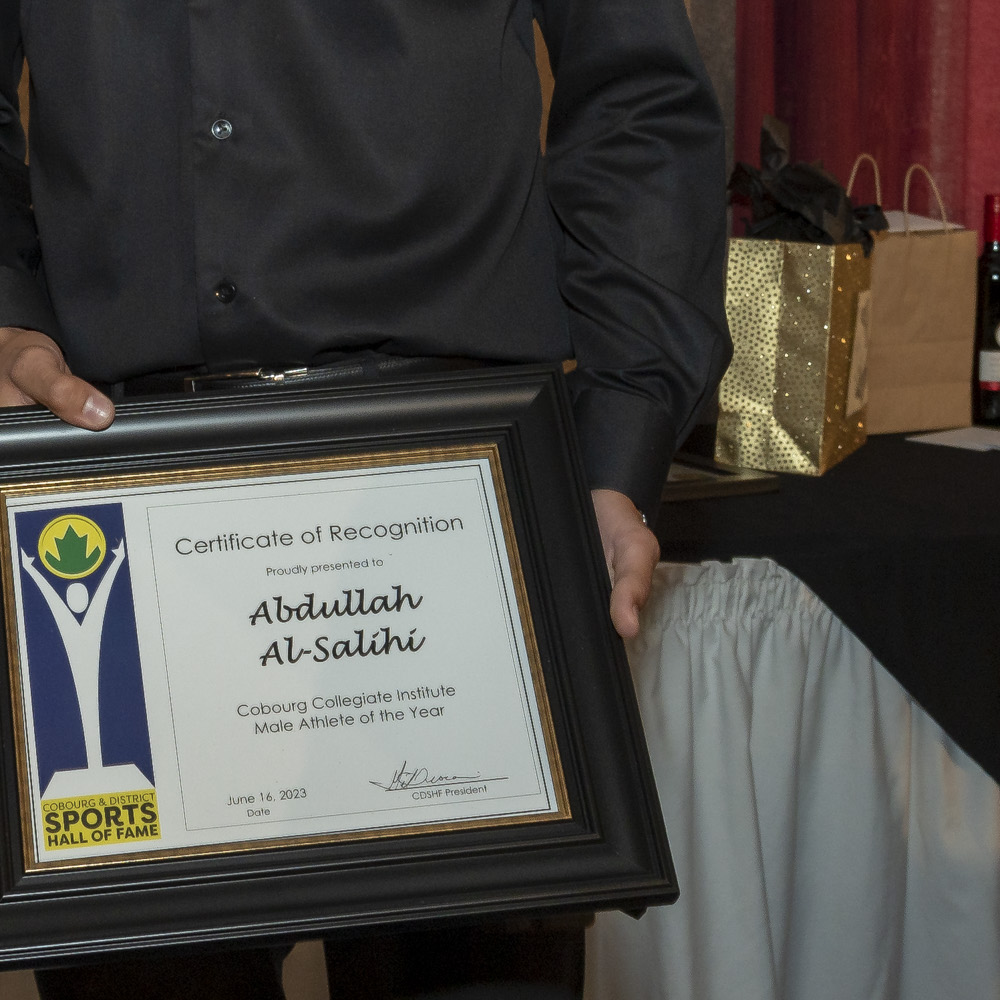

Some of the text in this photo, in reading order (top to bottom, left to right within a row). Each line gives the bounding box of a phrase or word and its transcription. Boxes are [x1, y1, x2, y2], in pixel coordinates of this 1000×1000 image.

[175, 516, 464, 555] Certificate of Recognition
[266, 558, 384, 576] Proudly presented to
[249, 585, 424, 626] Abdullah
[259, 626, 426, 666] Al-Salihi
[237, 684, 456, 717] Cobourg Collegiate Institute
[255, 705, 445, 735] Male Athlete of the Year
[43, 792, 155, 812] COBOURG & DISTRICT
[227, 788, 307, 806] June 16, 2023
[412, 785, 488, 800] CDSHF President
[45, 802, 158, 834] SPORTS
[247, 808, 271, 817] Date
[47, 824, 158, 847] HALL OF FAME
